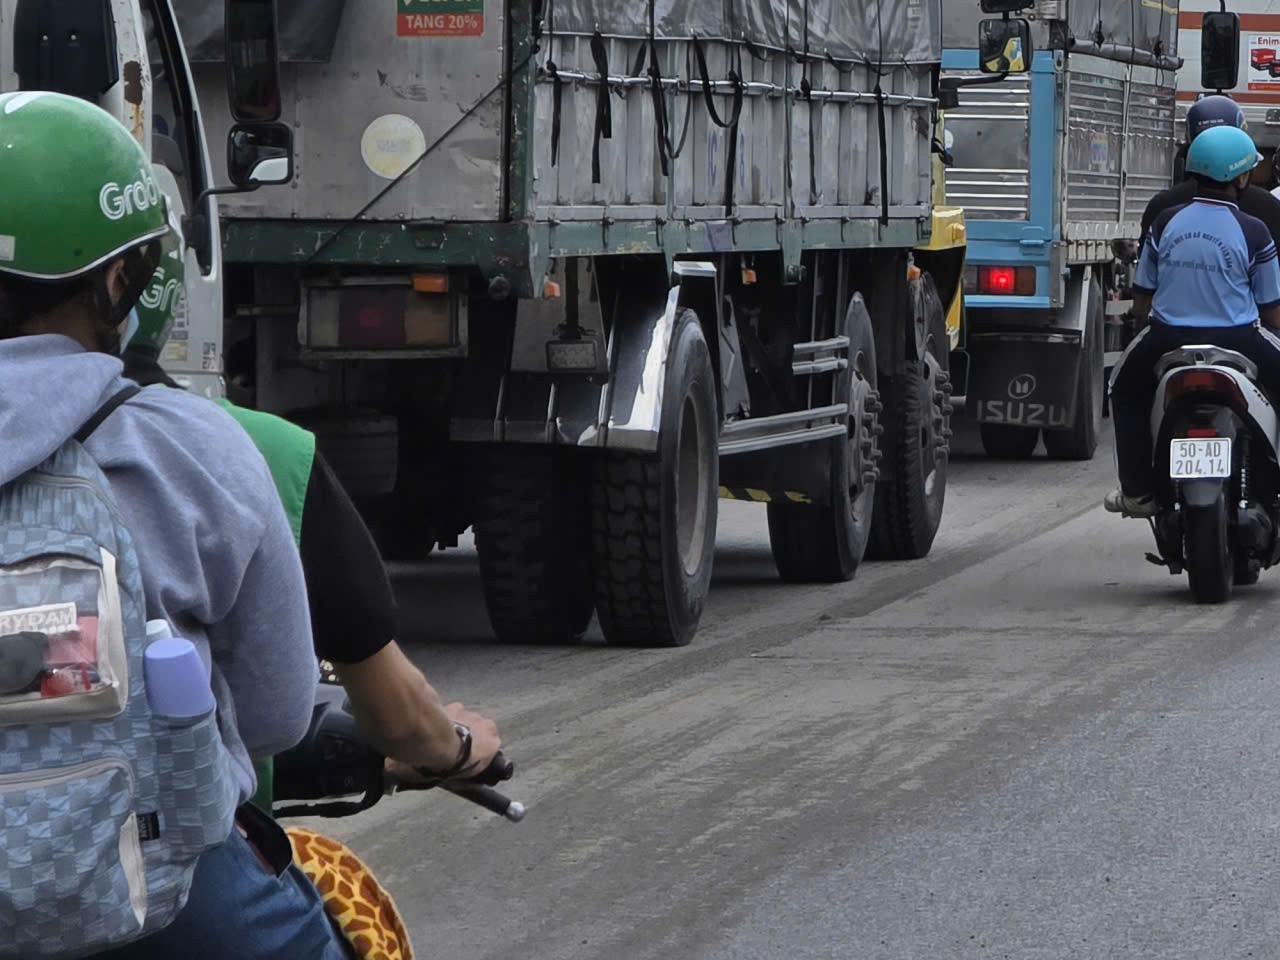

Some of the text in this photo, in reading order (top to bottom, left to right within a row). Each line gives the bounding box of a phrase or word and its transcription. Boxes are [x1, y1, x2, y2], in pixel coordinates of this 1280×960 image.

[449, 15, 478, 29] 20%
[99, 169, 158, 220] Grab
[977, 400, 1067, 426] ISUZU
[1179, 442, 1222, 458] 50-AD
[1175, 460, 1225, 476] 204.14
